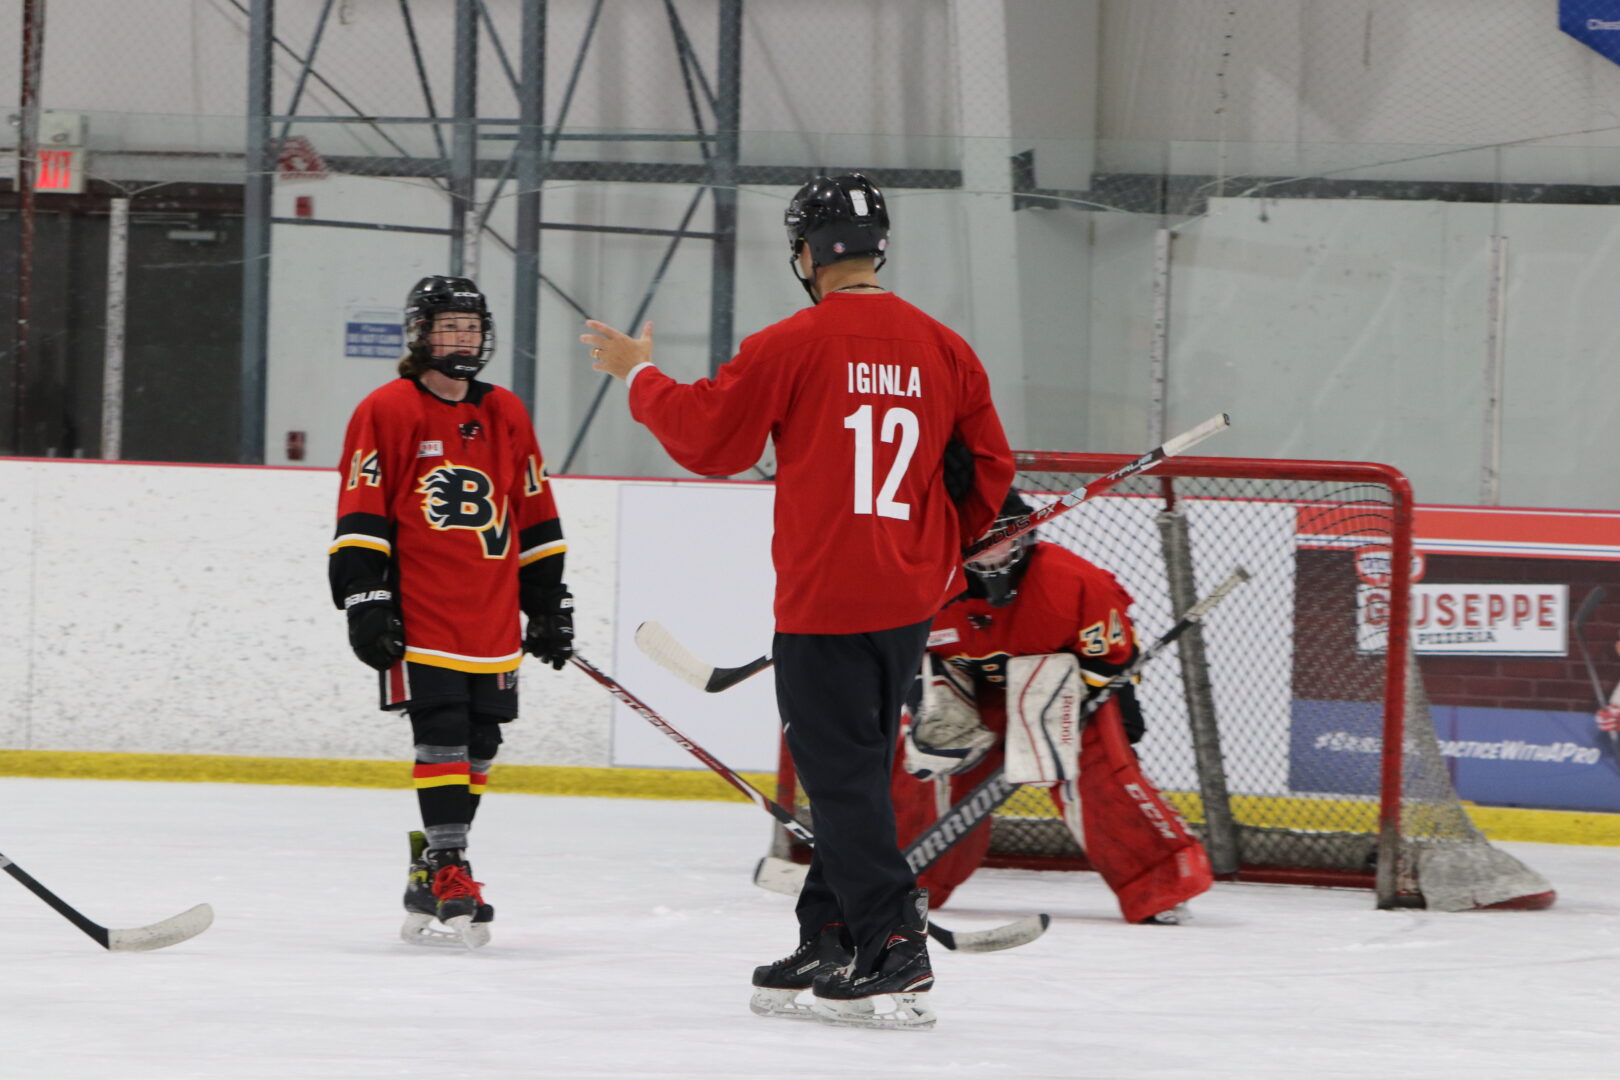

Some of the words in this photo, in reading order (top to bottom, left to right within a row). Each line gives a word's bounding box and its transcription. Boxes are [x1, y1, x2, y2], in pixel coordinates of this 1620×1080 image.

[33, 150, 73, 189] XIT
[848, 362, 922, 398] IGINLA
[347, 449, 382, 491] 14
[844, 404, 920, 521] 12
[1080, 608, 1126, 657] 34
[1364, 592, 1558, 628] GUSEPPE
[1417, 631, 1497, 645] PIZZERIA
[1061, 695, 1073, 745] Reebok
[905, 771, 1014, 875] ARRIOR
[1124, 783, 1178, 838] CCM
